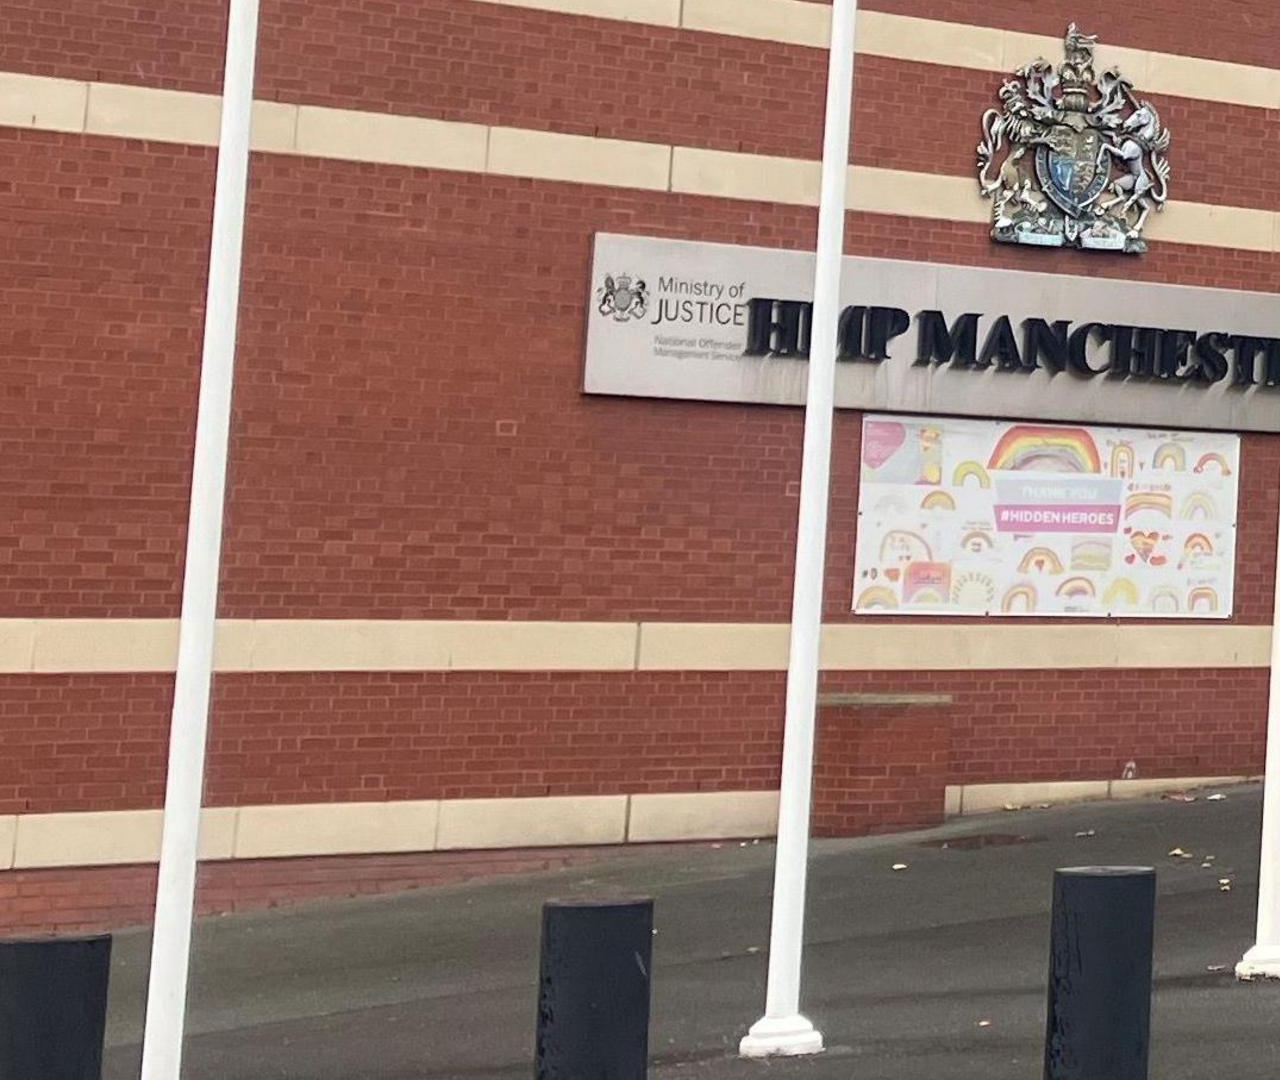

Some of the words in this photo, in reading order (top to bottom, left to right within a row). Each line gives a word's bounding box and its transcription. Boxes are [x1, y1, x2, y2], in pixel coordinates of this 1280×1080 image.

[658, 276, 724, 300] Ministry
[728, 281, 746, 298] of
[651, 298, 746, 326] JUSTICE
